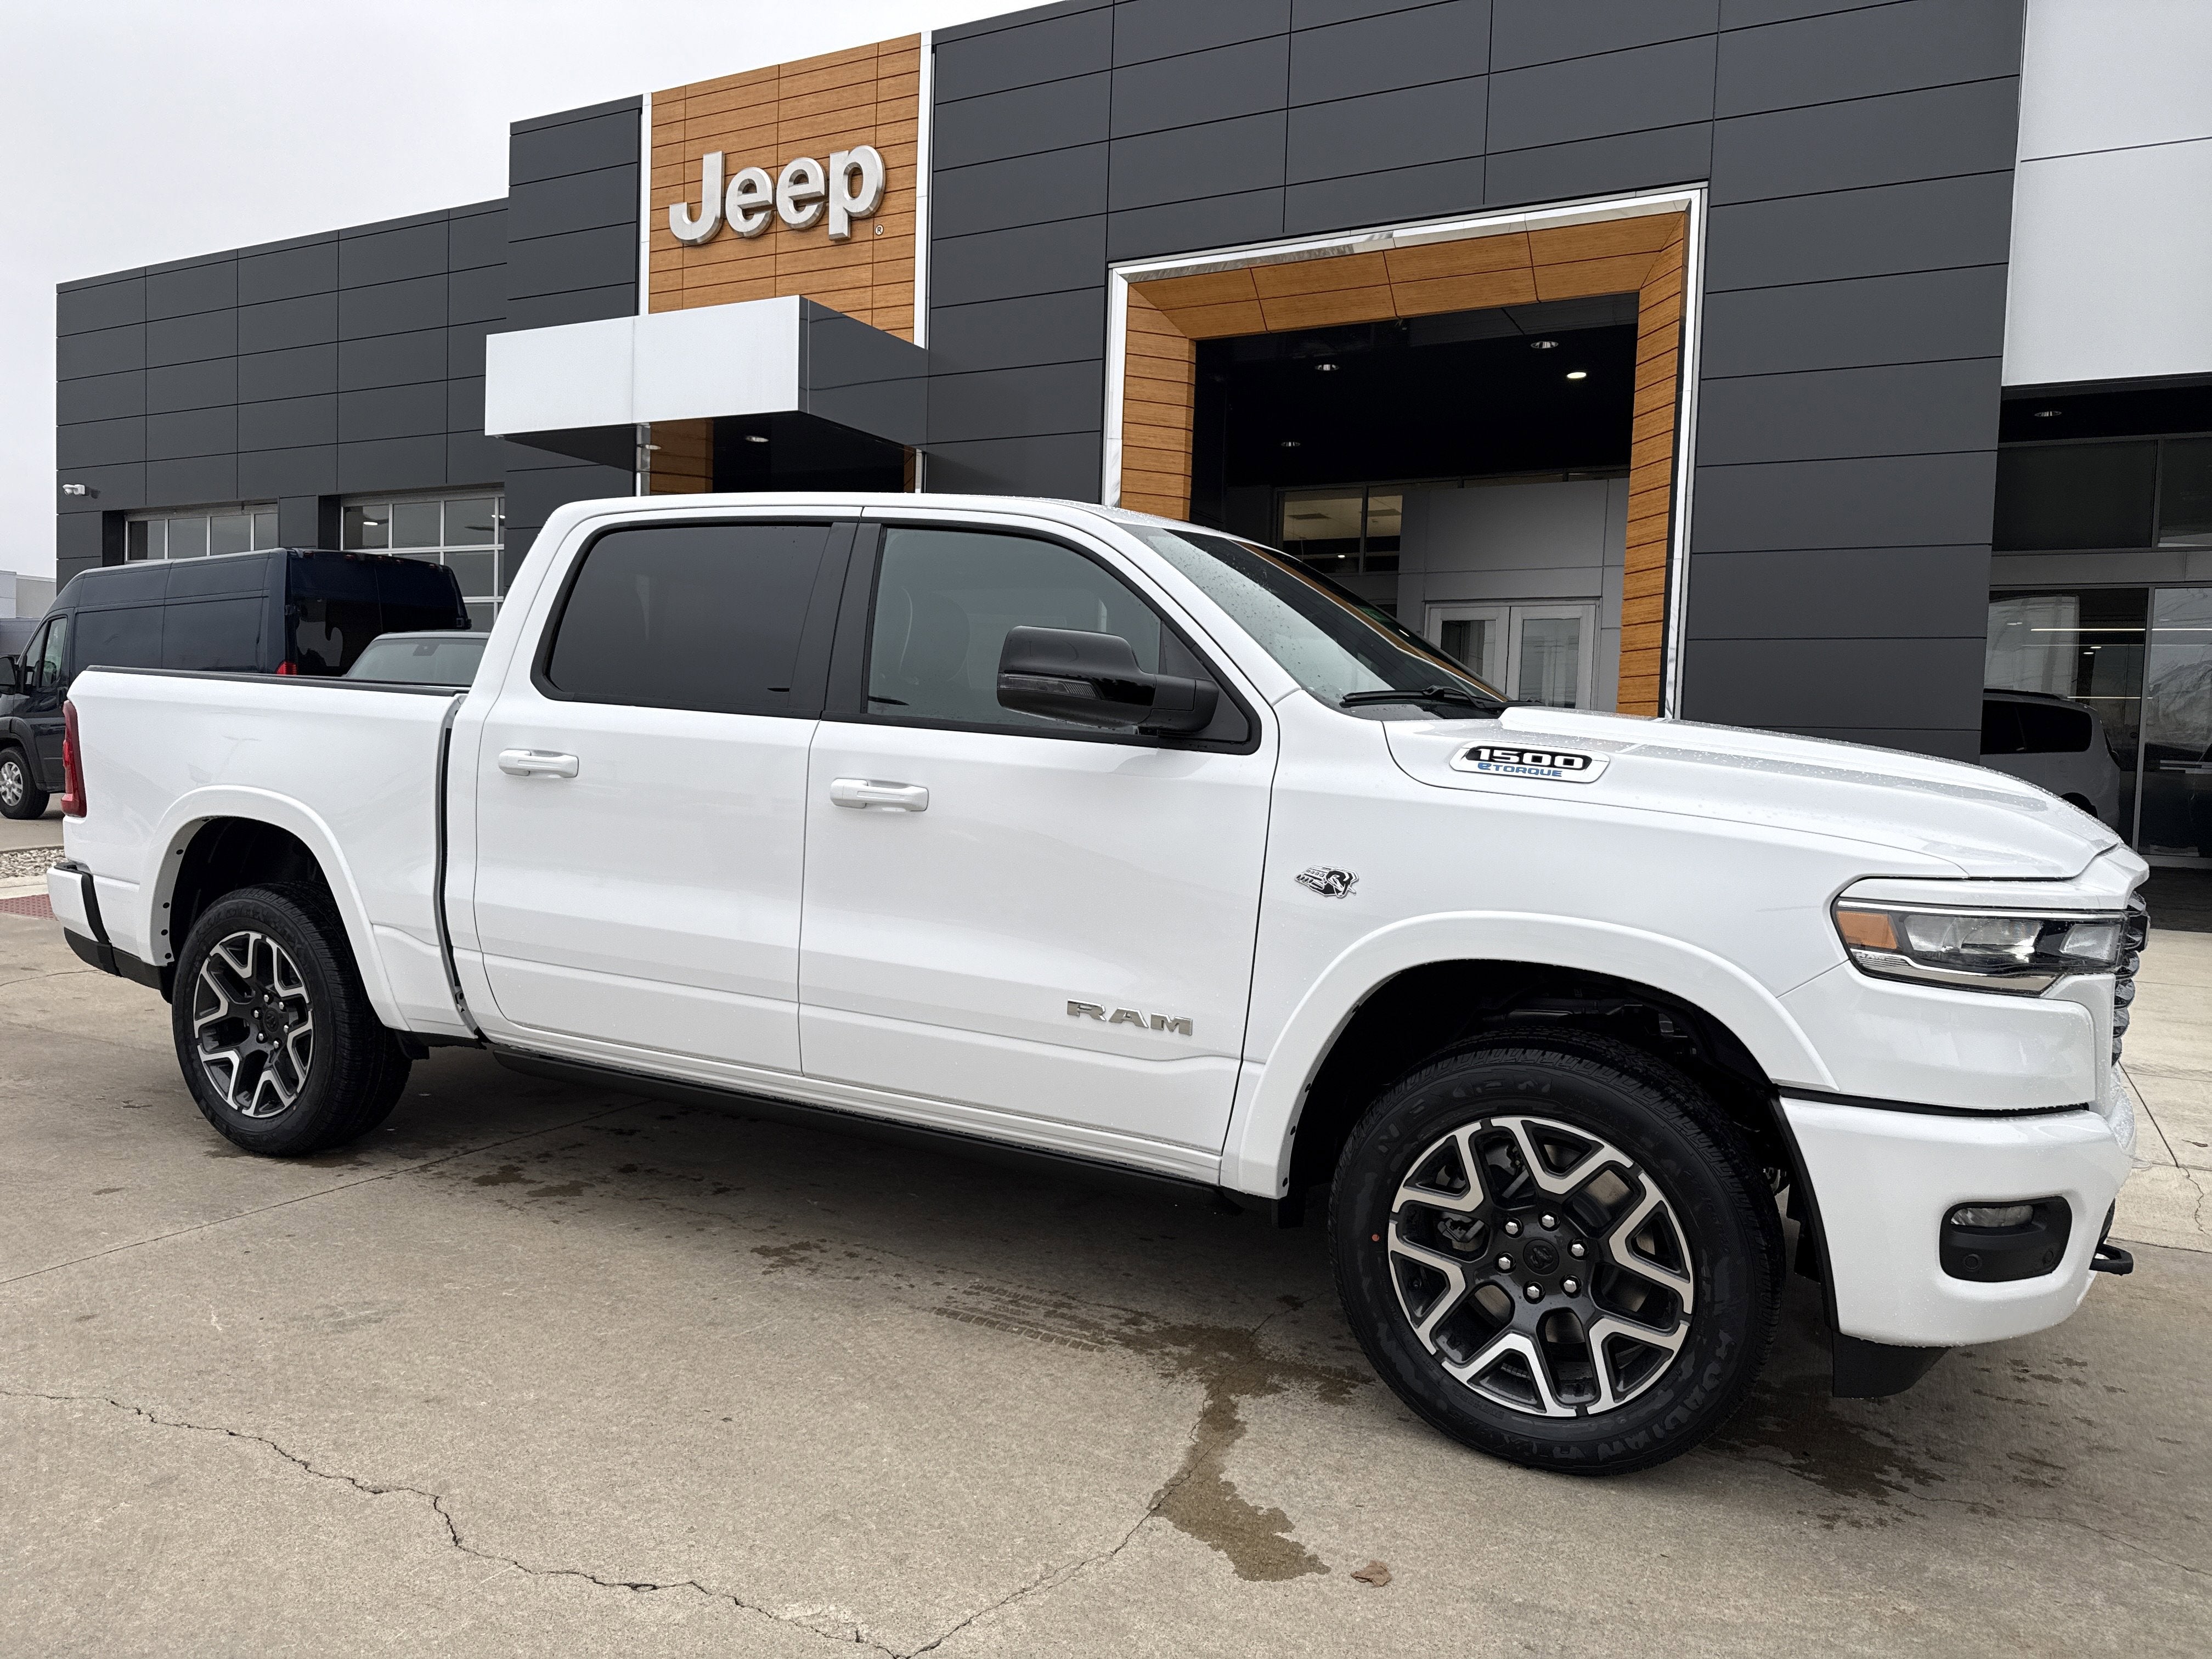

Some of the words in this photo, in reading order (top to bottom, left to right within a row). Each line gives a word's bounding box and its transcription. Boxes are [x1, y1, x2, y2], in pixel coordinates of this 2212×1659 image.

[669, 145, 885, 247] Jeep
[1476, 748, 1583, 768] 1500
[1067, 998, 1193, 1036] RAM
